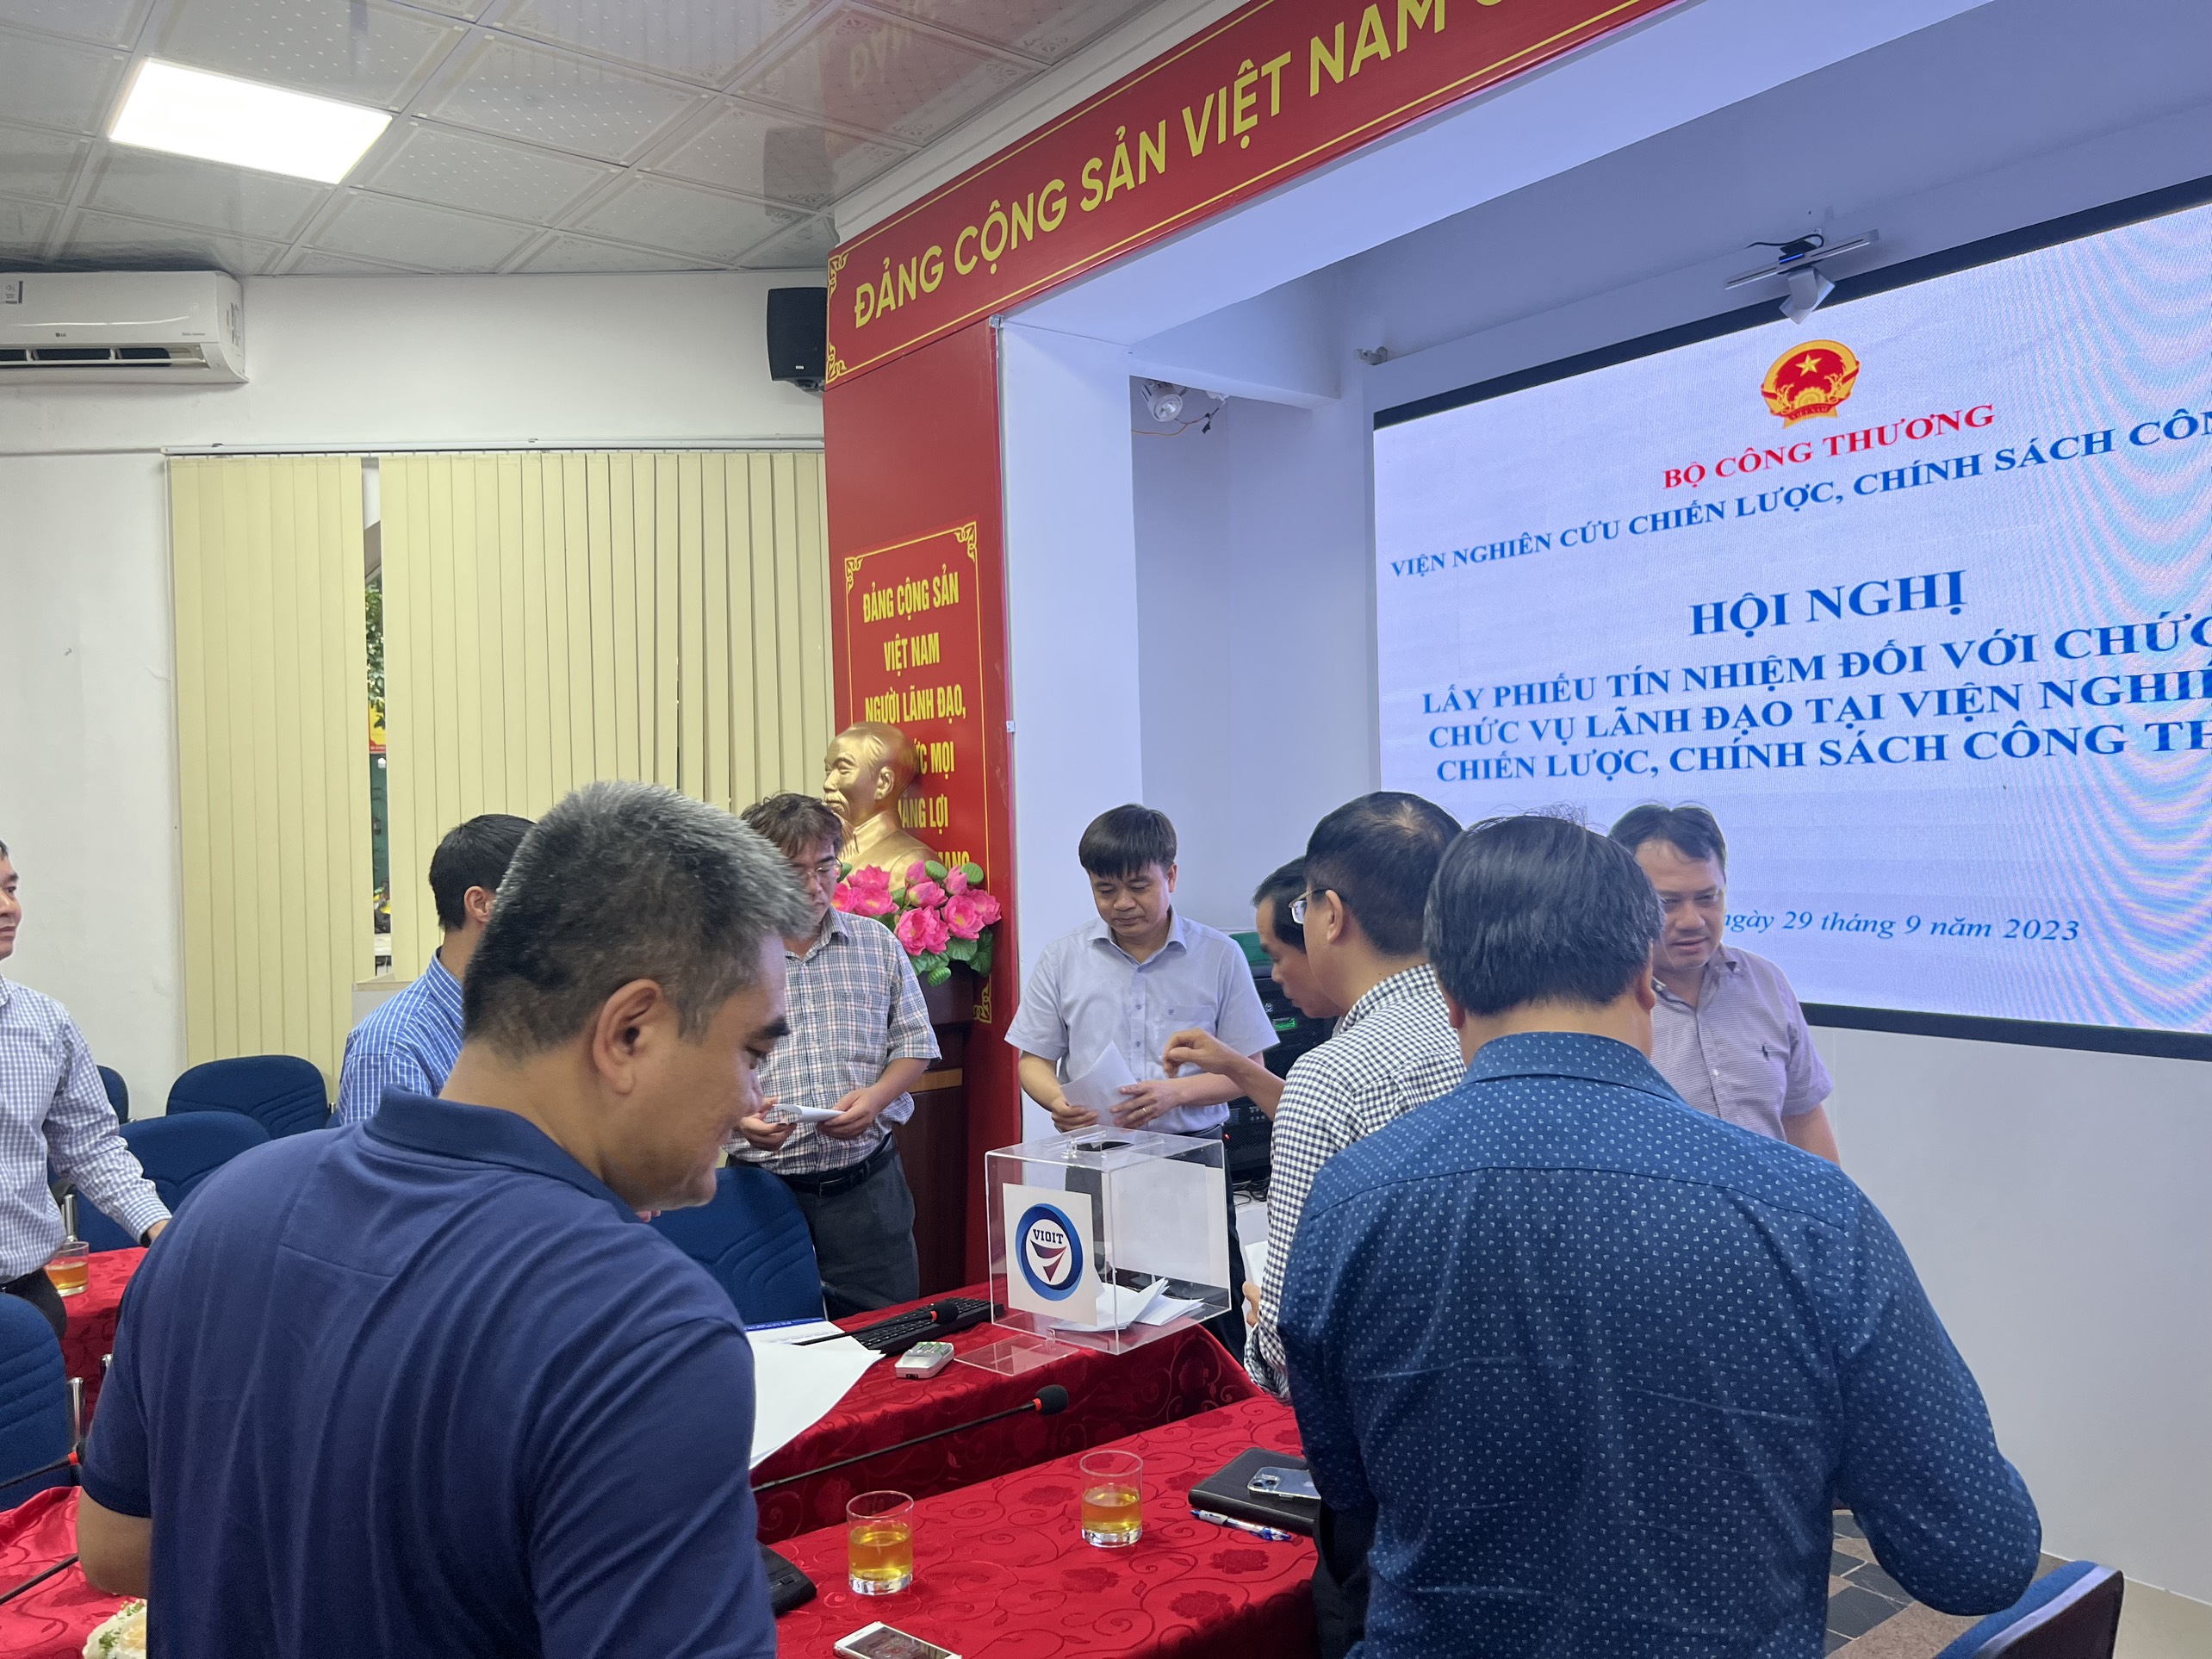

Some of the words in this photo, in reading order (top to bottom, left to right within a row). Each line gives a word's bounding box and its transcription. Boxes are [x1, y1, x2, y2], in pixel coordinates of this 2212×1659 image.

[854, 245, 944, 328] ĐẢNG
[954, 179, 1067, 274] CỘNG
[1080, 119, 1166, 212] SẢN
[1182, 51, 1291, 157] VIỆT
[1310, 0, 1445, 97] NAM
[1663, 462, 1706, 488] BỘ
[1716, 443, 1811, 476] CÔNG
[1823, 404, 1994, 456] THƯƠNG
[1391, 553, 1445, 576] VIỆN
[1453, 532, 1550, 567] NGHIÊN
[1560, 520, 1619, 547] CỨU
[1629, 500, 1725, 534] CHIẾN
[1736, 482, 1843, 517] LƯỢC,
[1854, 454, 1982, 495] CHÍNH
[1995, 428, 2116, 471] SÁCH
[863, 581, 894, 623] ĐẢNG
[897, 576, 929, 621] CỘNG
[933, 563, 960, 608] SẢN
[1690, 593, 1790, 637] HỘI
[1805, 570, 1967, 622] NGHỊ
[884, 633, 908, 676] VIỆT
[910, 632, 941, 667] NAM
[1424, 684, 1483, 713] LẤY
[1494, 673, 1595, 707] PHIẾU
[1606, 665, 1670, 697] TÍN
[1682, 655, 1825, 692] NHIỆM
[1838, 639, 1926, 678] ĐỐI
[1940, 628, 2038, 668] VỚI
[865, 687, 901, 724] NGƯỜI
[903, 685, 935, 723] LÃNH
[937, 684, 966, 724] ĐẠO,
[1429, 717, 1519, 748] CHỨC
[1529, 718, 1574, 746] VỤ
[1587, 706, 1691, 737] LÃNH
[1702, 701, 1793, 736] ĐẠO
[1805, 694, 1885, 730] TẠI
[1898, 682, 2023, 723] VIỆN
[930, 741, 955, 780] MỌI
[1437, 751, 1535, 781] CHIẾN
[1546, 749, 1658, 781] LƯỢC,
[1670, 736, 1806, 772] CHÍNH
[1820, 730, 1948, 766] SÁCH
[1964, 720, 2126, 760] CÔNG
[929, 793, 949, 835] LỢI
[1782, 911, 1812, 929] 29
[1822, 912, 1896, 939] tháng
[1905, 916, 1921, 934] 9
[1930, 917, 1992, 937] năm
[2003, 918, 2079, 941] 2023
[1033, 1229, 1064, 1244] VIOIT
